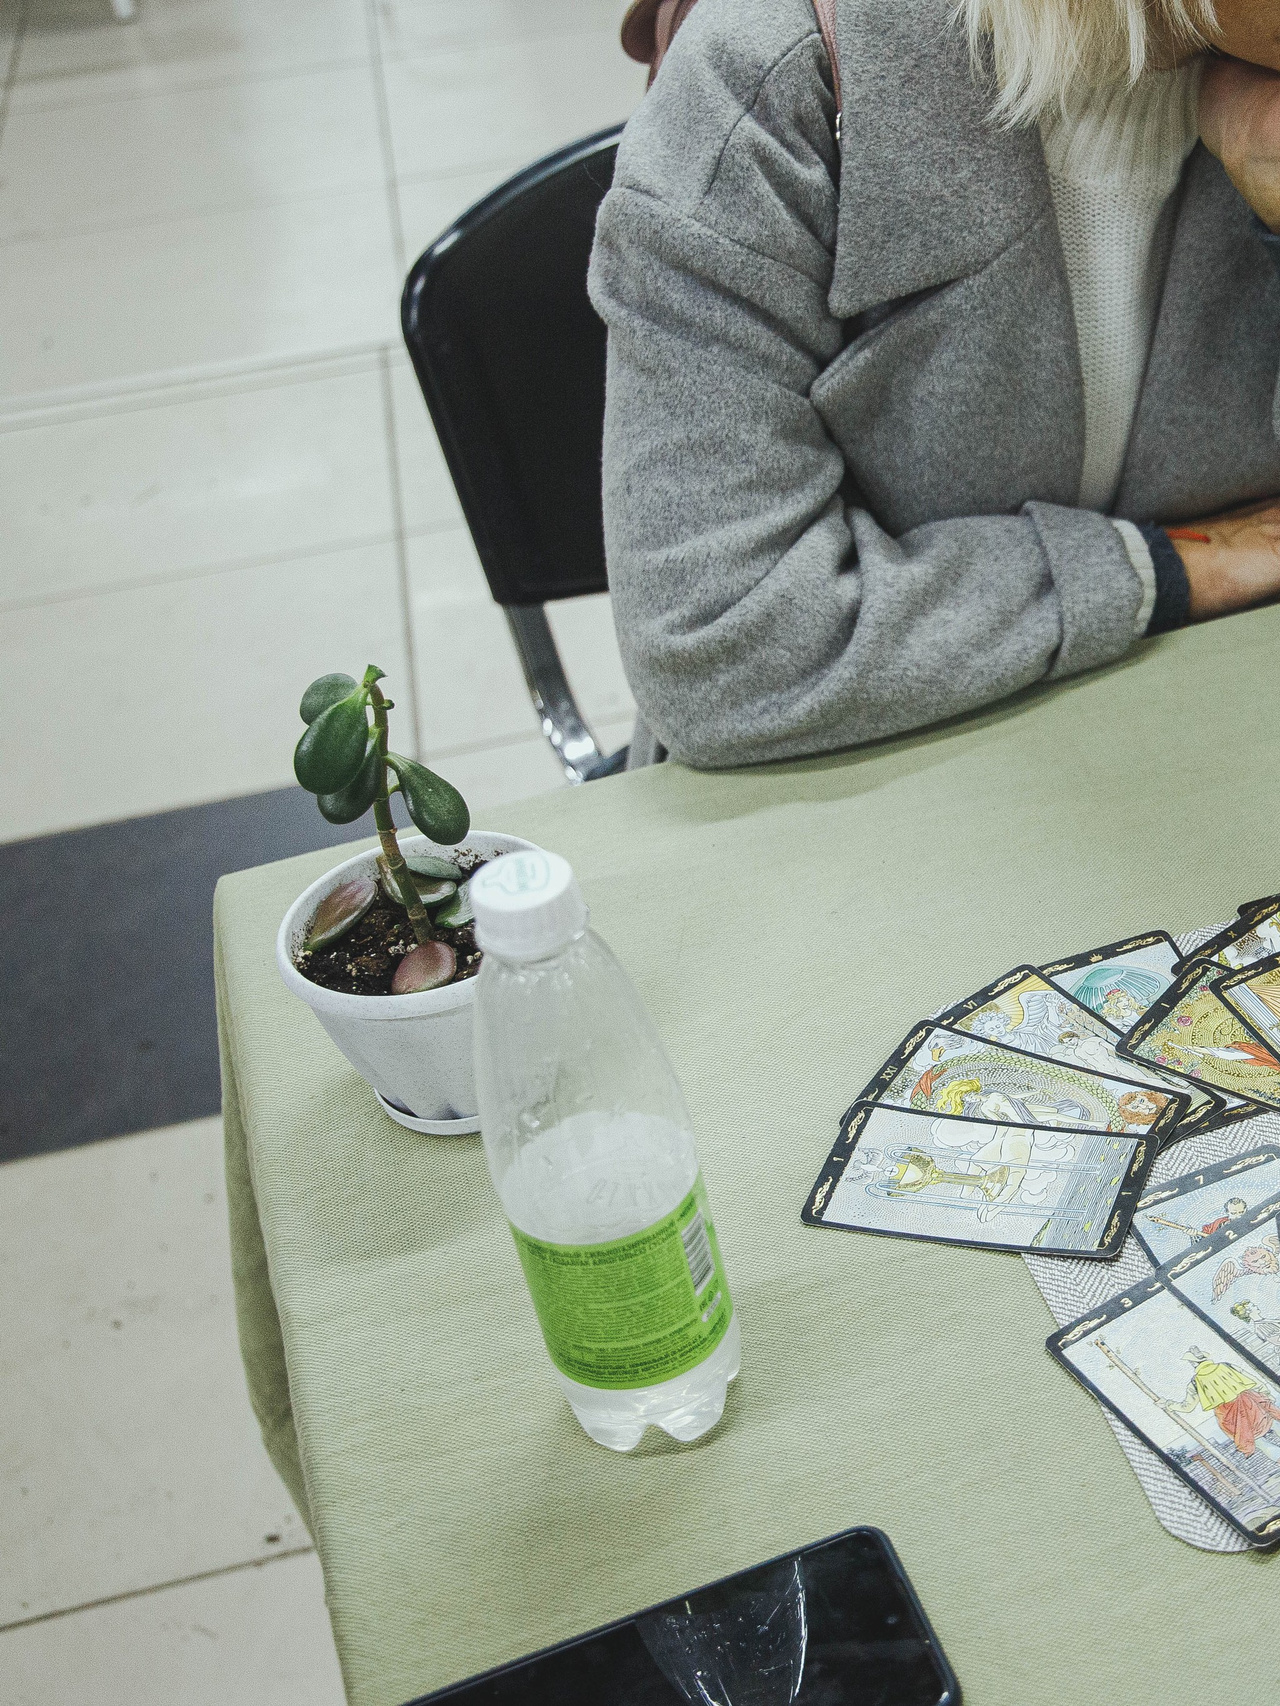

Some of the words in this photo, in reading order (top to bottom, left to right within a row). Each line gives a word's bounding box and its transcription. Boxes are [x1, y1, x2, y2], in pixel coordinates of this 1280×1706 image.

[1227, 930, 1237, 939] X
[962, 1000, 978, 1010] VI
[880, 1065, 898, 1081] XXI
[1194, 1175, 1204, 1185] 7
[1225, 1230, 1238, 1240] 2
[1120, 1297, 1133, 1308] 3
